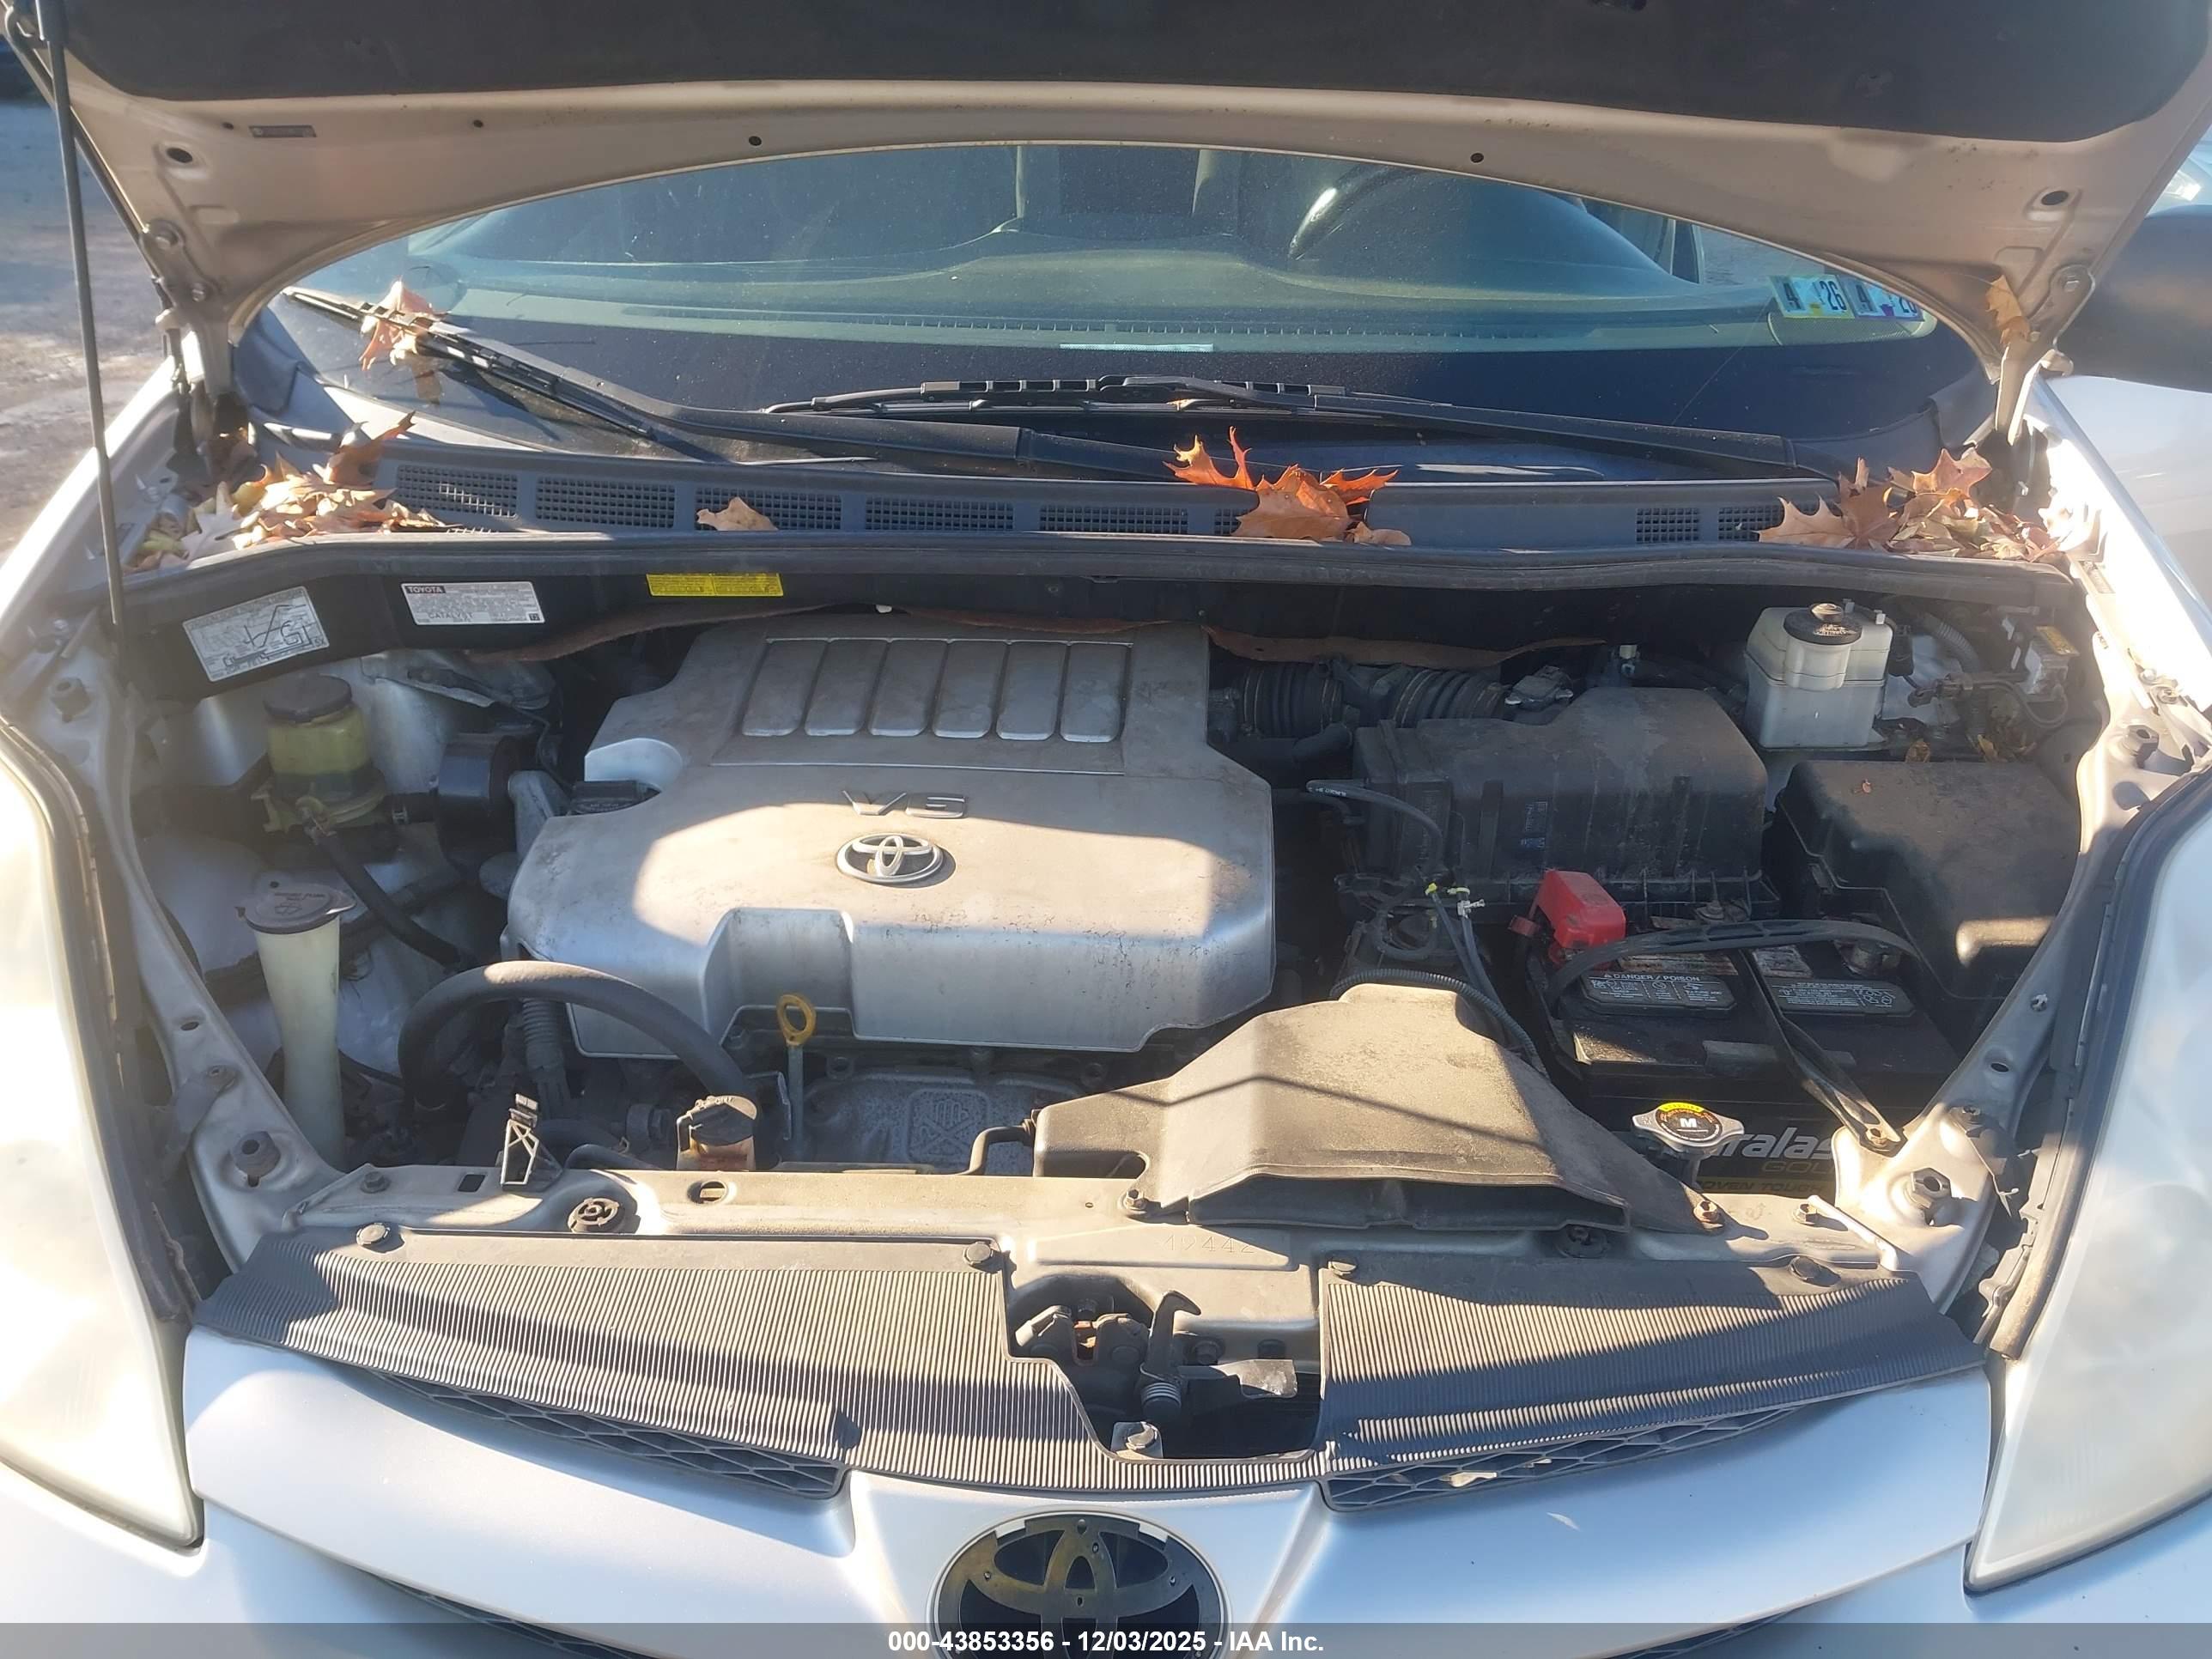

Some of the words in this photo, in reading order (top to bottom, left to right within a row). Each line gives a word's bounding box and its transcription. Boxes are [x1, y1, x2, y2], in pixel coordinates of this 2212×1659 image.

[1783, 282, 1802, 310] 4
[1819, 280, 1847, 311] 26
[1856, 284, 1874, 312] 4
[842, 789, 969, 819] V6
[1717, 1127, 1832, 1160] ralas
[1762, 1161, 1835, 1175] GOL
[1702, 1180, 1755, 1191] OVEN
